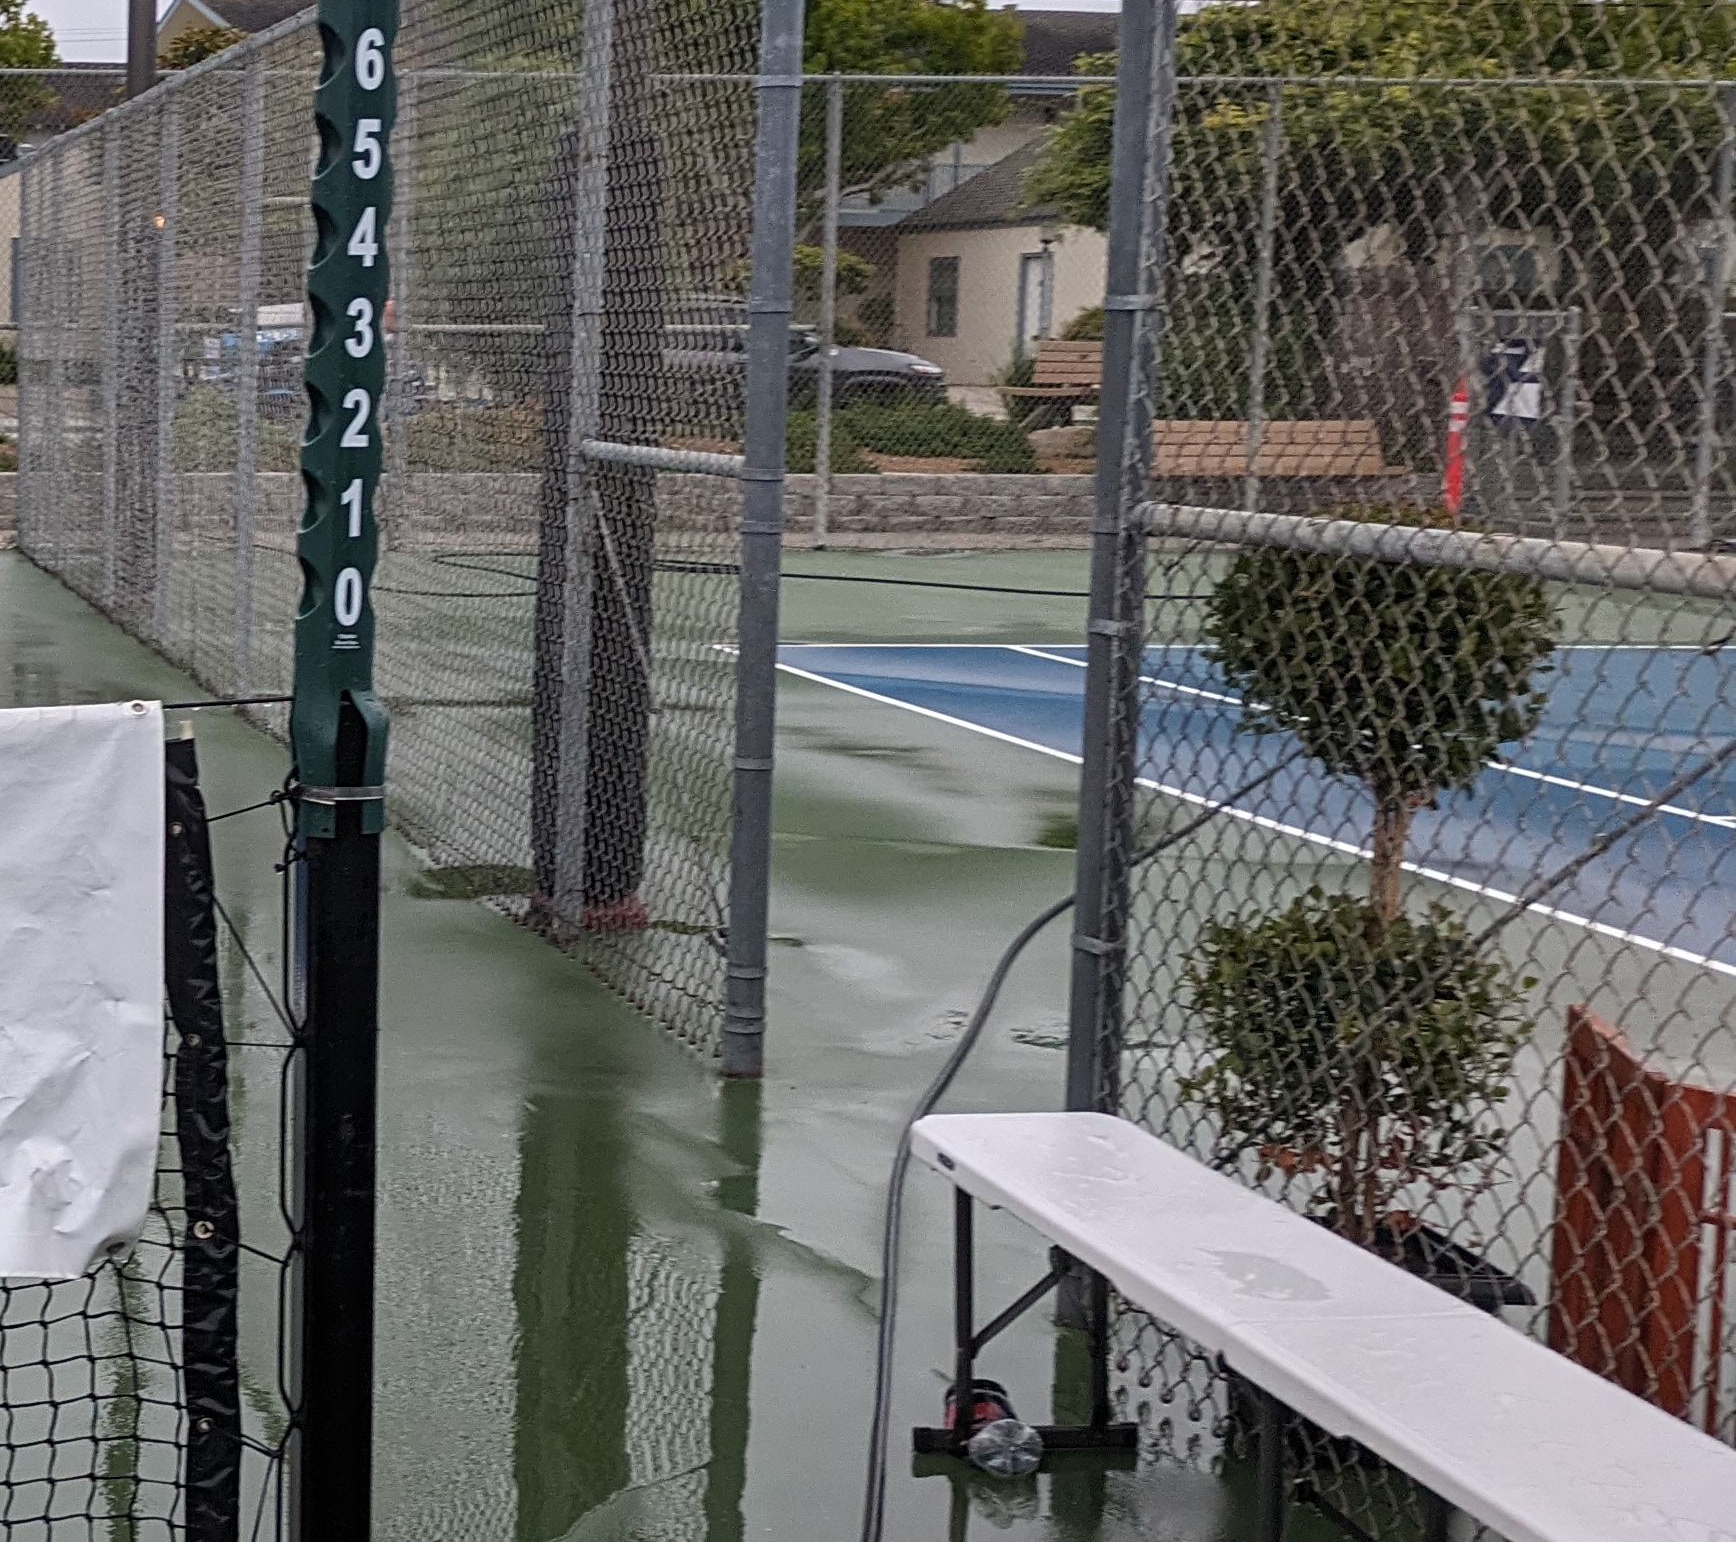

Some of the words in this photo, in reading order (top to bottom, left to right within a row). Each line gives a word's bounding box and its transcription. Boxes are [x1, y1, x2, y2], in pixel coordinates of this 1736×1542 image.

[356, 27, 385, 91] 6
[352, 118, 381, 181] 5
[347, 206, 378, 267] 4
[344, 297, 374, 358] 3
[340, 388, 370, 449] 2
[340, 478, 363, 538] 1
[334, 567, 363, 626] 0
